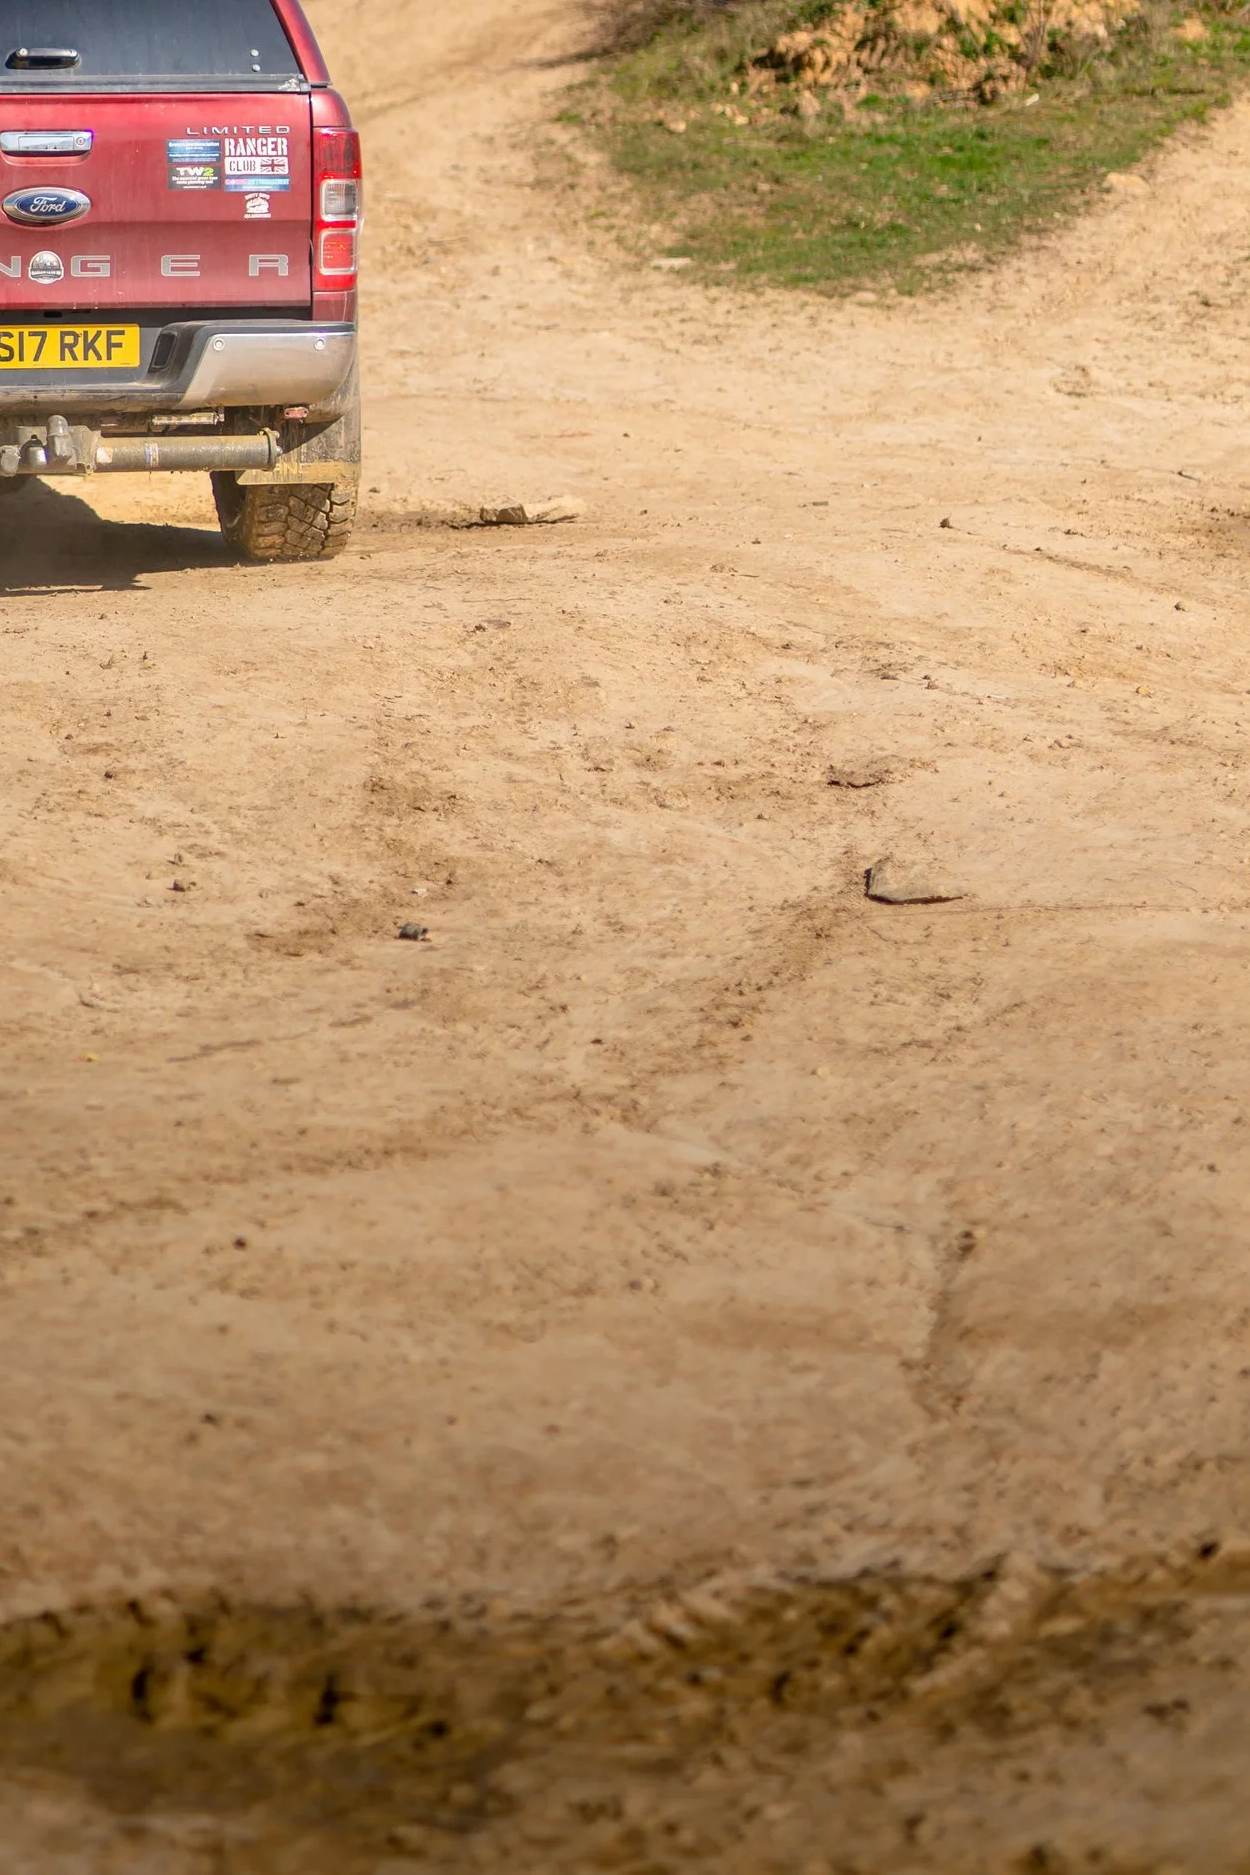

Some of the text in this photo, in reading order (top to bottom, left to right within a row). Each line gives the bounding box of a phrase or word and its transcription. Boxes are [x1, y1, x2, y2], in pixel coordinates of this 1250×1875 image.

[186, 125, 291, 136] LIMITED
[224, 137, 288, 156] RANGER
[176, 166, 214, 177] TW2
[229, 160, 256, 172] CLUB
[29, 196, 67, 213] Ford
[59, 329, 126, 362] RKF
